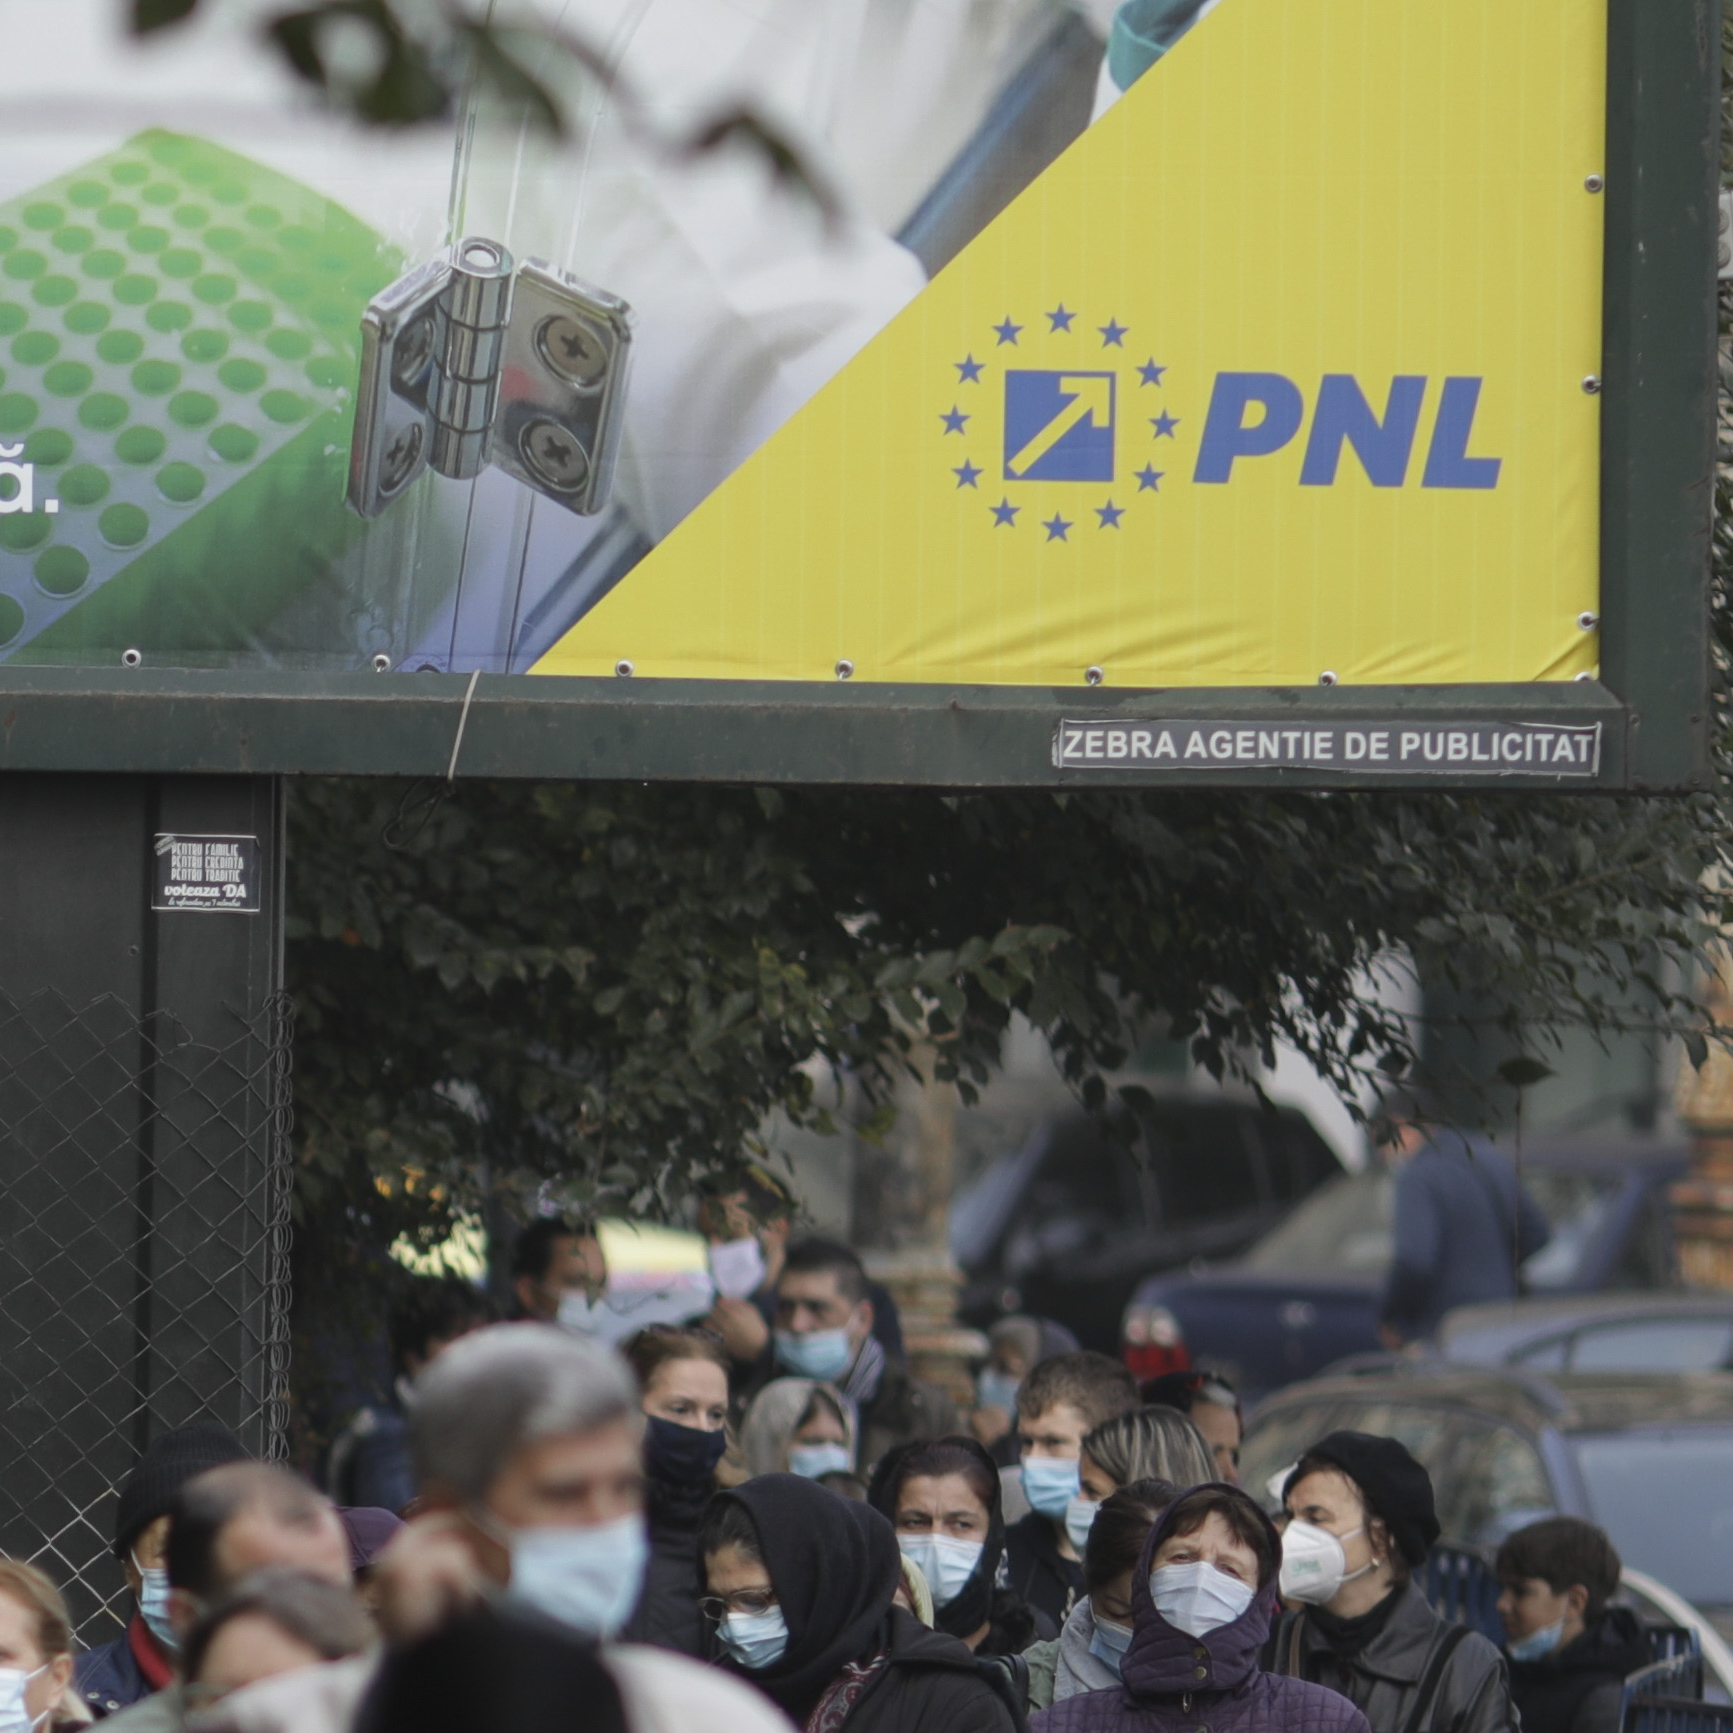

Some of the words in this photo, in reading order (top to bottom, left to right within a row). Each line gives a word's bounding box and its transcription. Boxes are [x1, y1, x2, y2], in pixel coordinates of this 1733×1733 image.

[1192, 371, 1503, 489] PNL
[1063, 730, 1177, 759] ZEBRA
[1184, 730, 1334, 761] AGENTIE
[1344, 731, 1390, 761] DE
[1400, 731, 1594, 764] PUBLICITAT
[172, 843, 202, 856] PENTRU
[172, 855, 202, 868] PENTRU
[171, 868, 202, 881] PENTRU
[222, 884, 247, 898] DA
